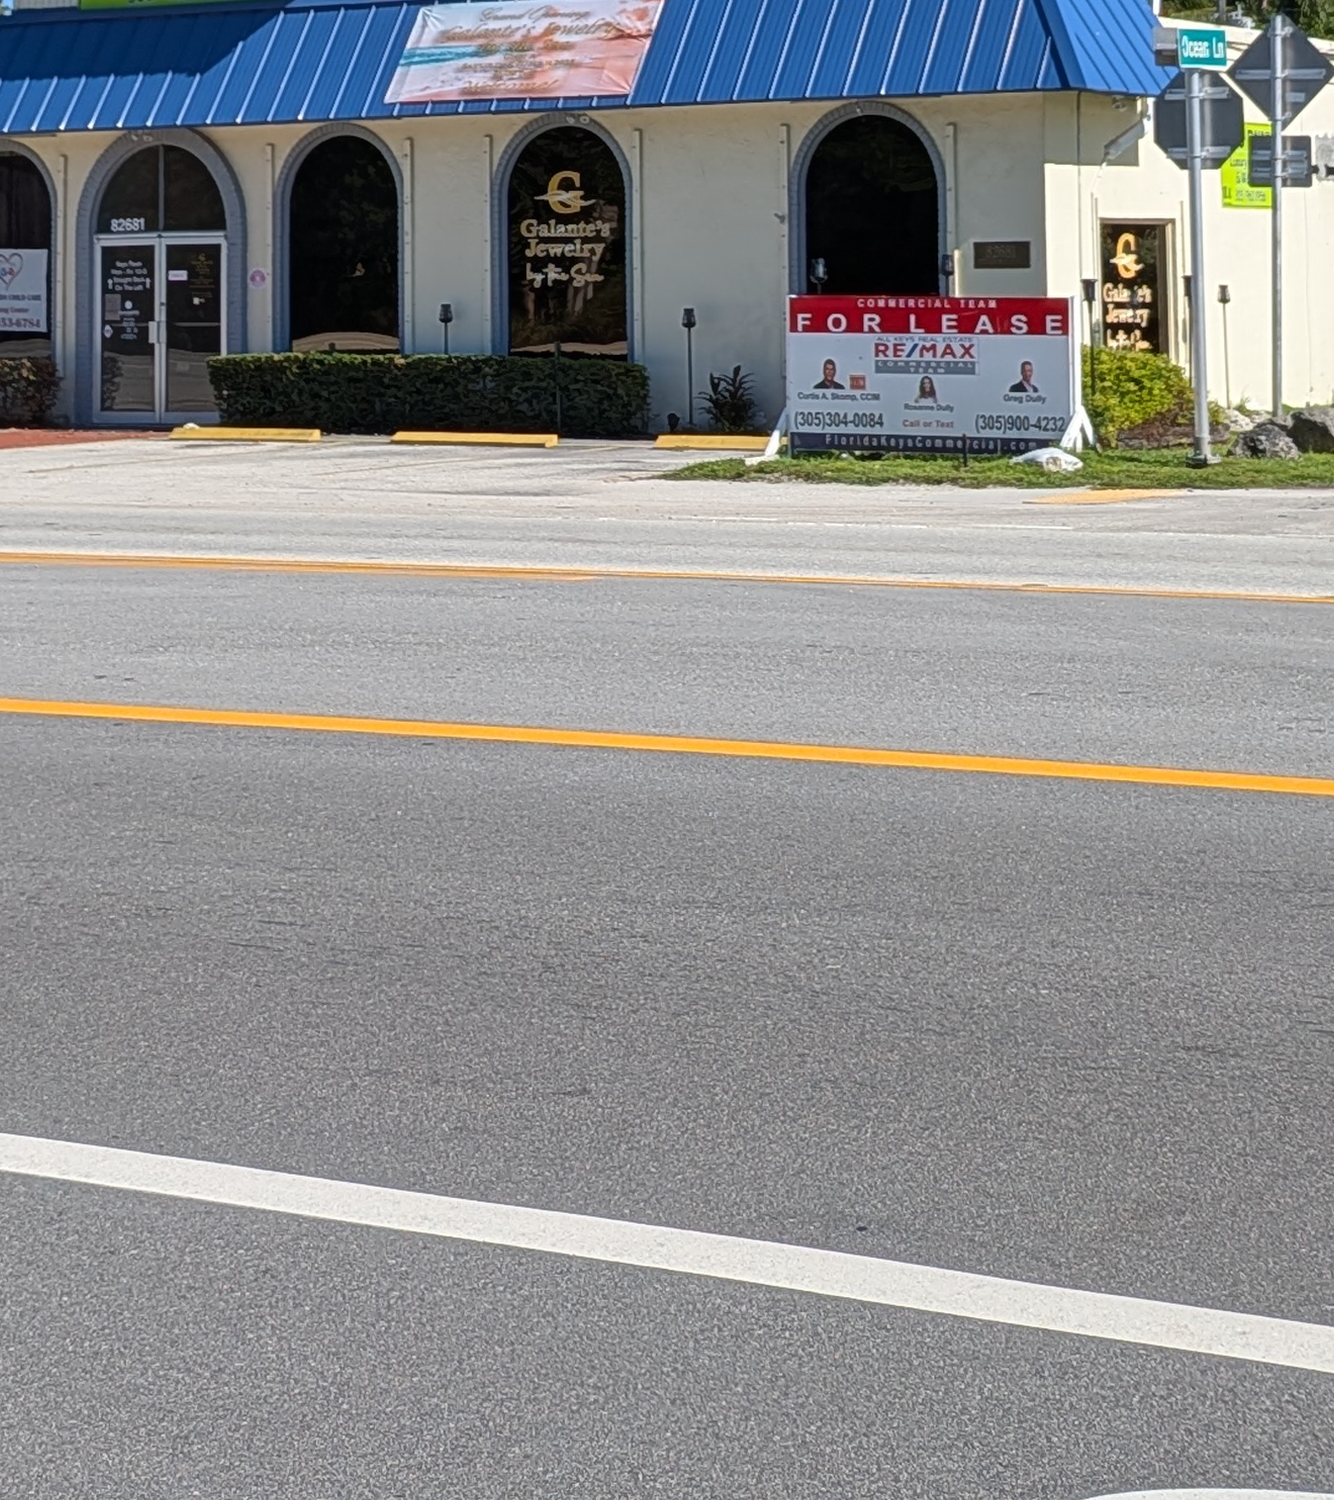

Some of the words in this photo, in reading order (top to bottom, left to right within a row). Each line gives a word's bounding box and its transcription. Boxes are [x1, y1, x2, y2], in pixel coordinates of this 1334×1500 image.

[1181, 35, 1210, 58] Ocean
[1212, 37, 1224, 58] Ln
[110, 217, 146, 232] 82681
[519, 218, 611, 238] Galante's
[525, 238, 606, 262] Jewelry
[525, 262, 545, 288] by
[857, 299, 952, 309] COMMERCIAL
[959, 299, 997, 309] TEAM
[796, 313, 882, 333] FOR
[909, 314, 1063, 335] LEASE
[874, 343, 976, 359] RE/MAX
[1003, 394, 1024, 404] Greg
[794, 410, 885, 430] (305)304-0084
[902, 419, 920, 428] Call
[922, 420, 933, 428] or
[935, 419, 955, 428] Text
[974, 414, 1067, 434] (305)900-4232
